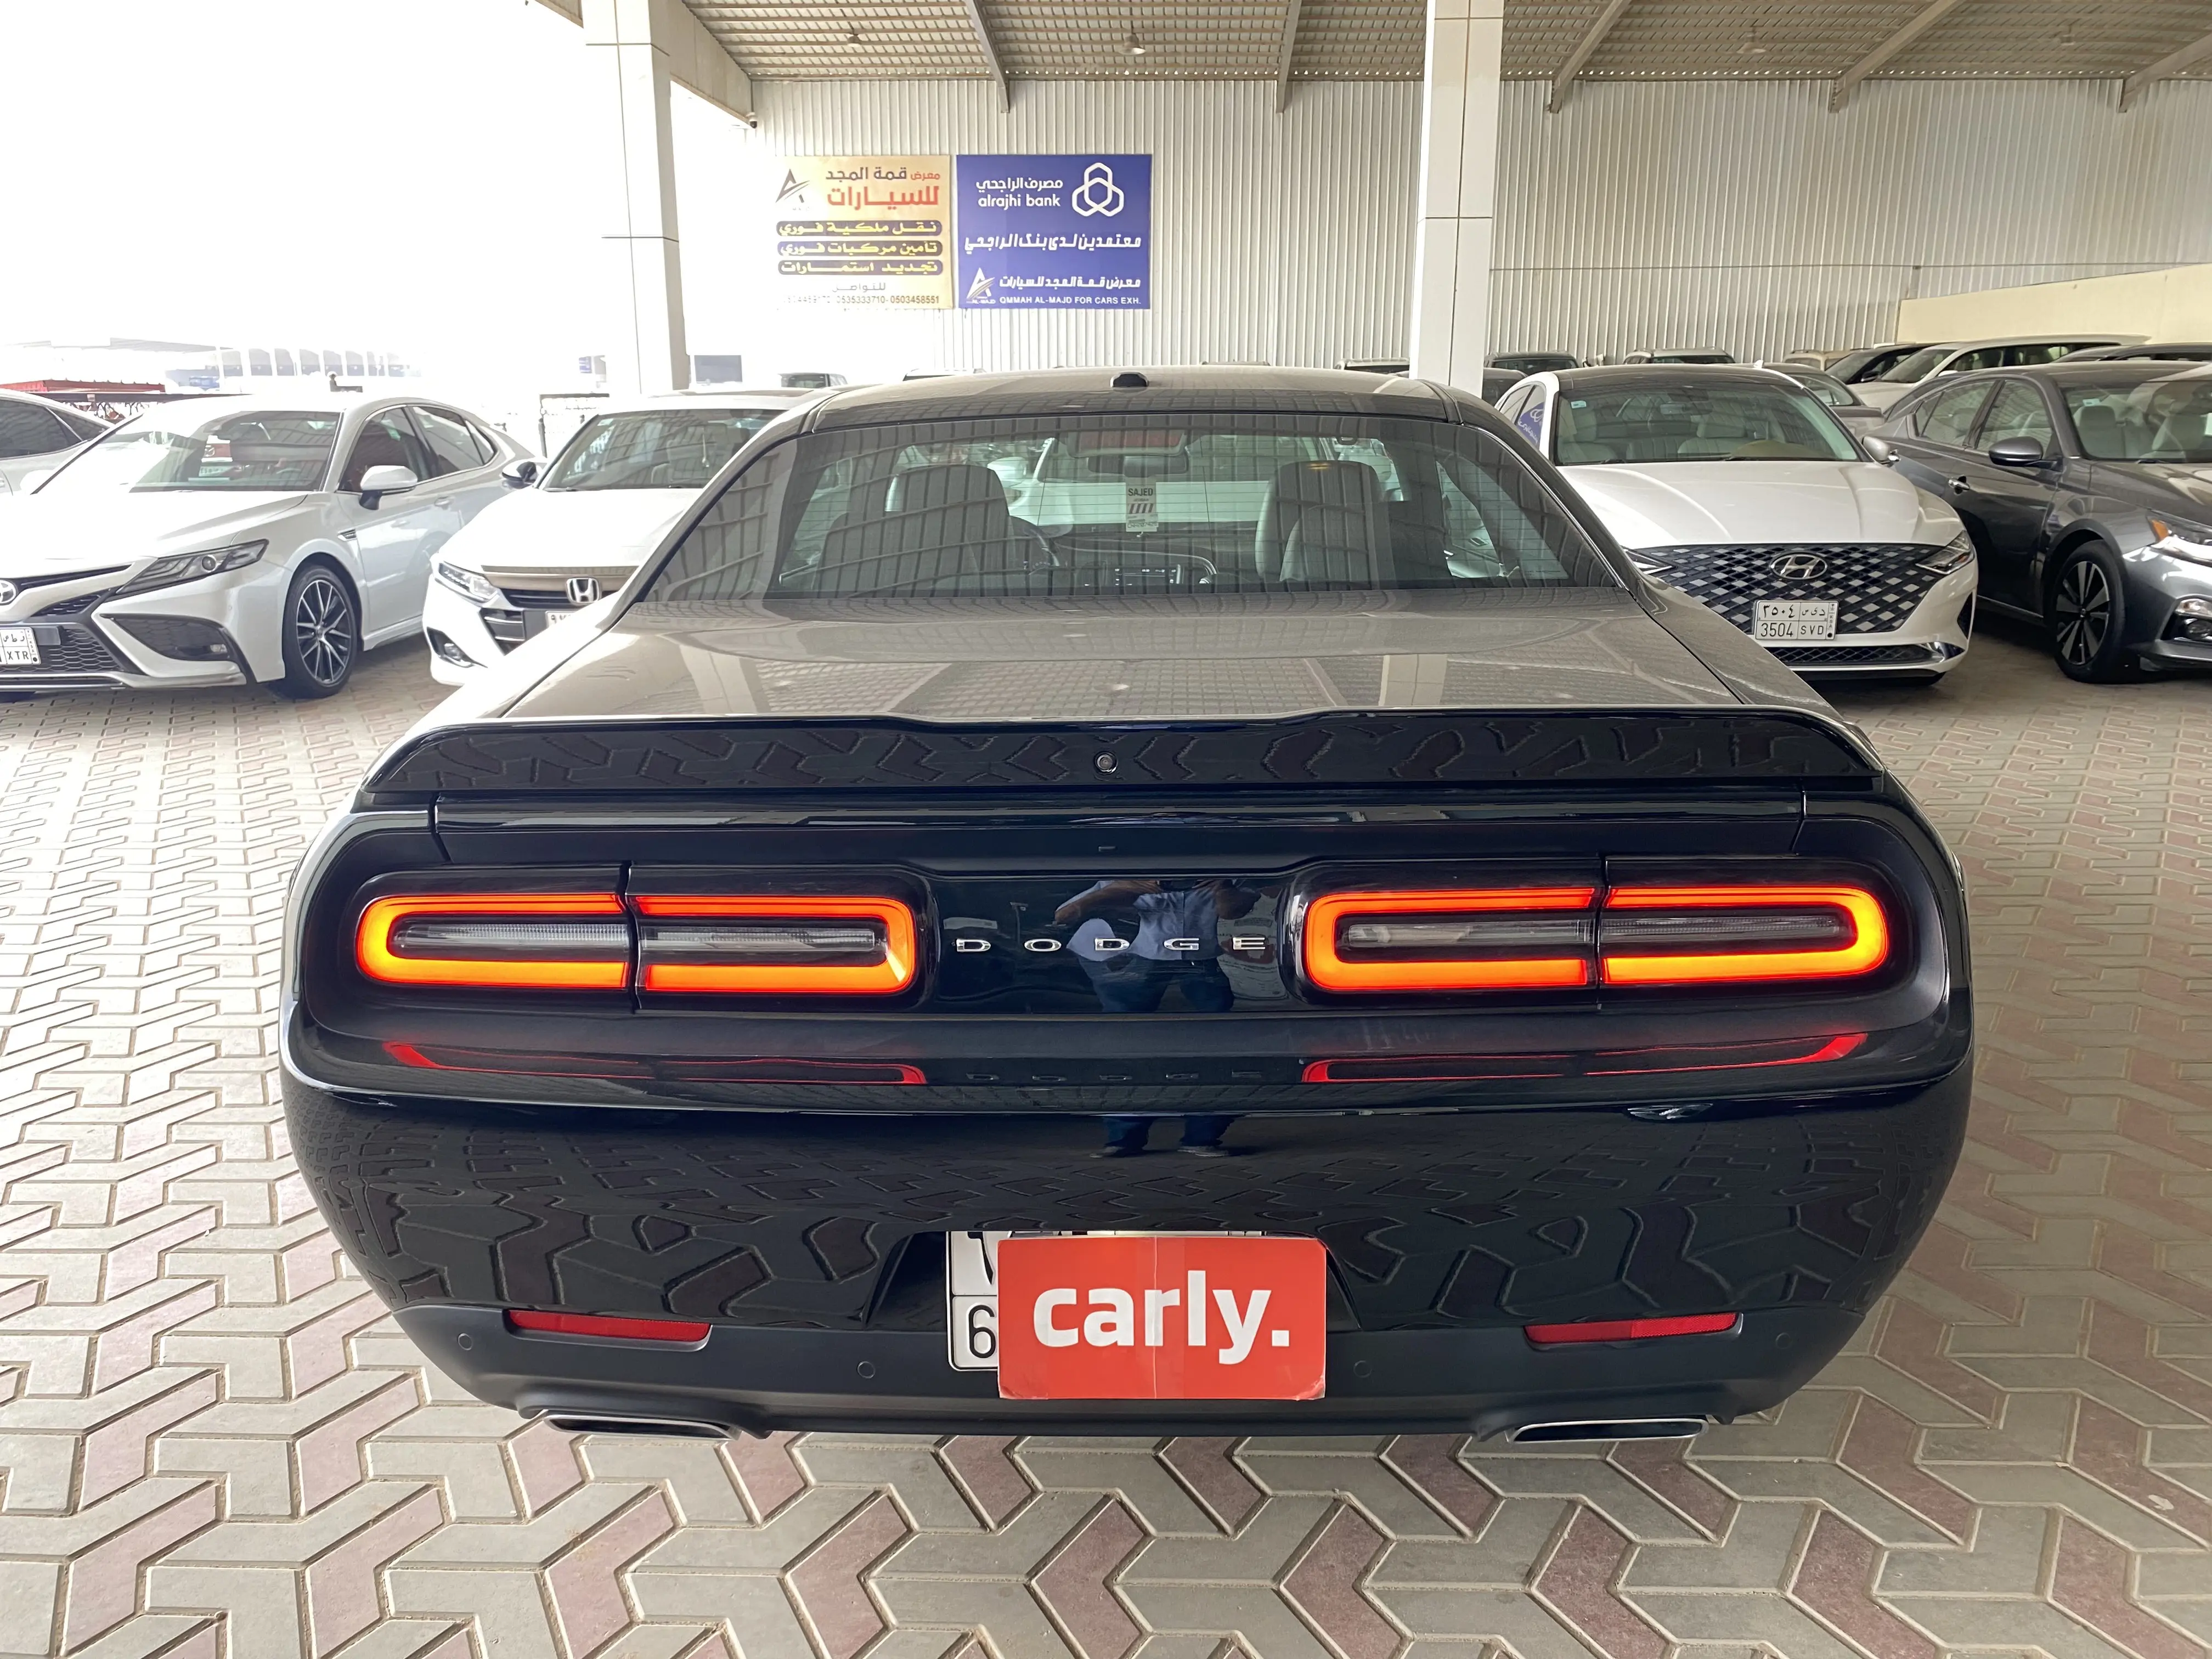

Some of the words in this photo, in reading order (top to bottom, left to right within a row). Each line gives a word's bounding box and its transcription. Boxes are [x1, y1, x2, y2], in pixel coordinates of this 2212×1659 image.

[825, 166, 868, 182] المجد
[873, 166, 906, 180] قمة
[910, 171, 940, 181] معرض
[975, 177, 1023, 193] الراجحي
[1024, 177, 1063, 191] مصرف
[827, 185, 939, 210] للسيارات
[978, 194, 1021, 211] alrajhi
[1026, 194, 1060, 207] bank
[827, 222, 889, 235] ملكية
[892, 222, 937, 234] نقل
[964, 233, 1018, 255] الراجحي
[1019, 233, 1047, 251] بنك
[1078, 234, 1142, 251] معتمدين
[828, 243, 896, 256] مركبات
[882, 261, 938, 274] تجديد
[1000, 276, 1045, 290] للسيارات
[1045, 276, 1077, 290] المجد
[1077, 276, 1105, 287] قمة
[1105, 276, 1141, 290] معرض
[1128, 488, 1153, 496] SAJED
[1760, 622, 1793, 637] 3504
[956, 936, 1266, 952] DODGE
[1034, 1270, 1290, 1364] carly.
